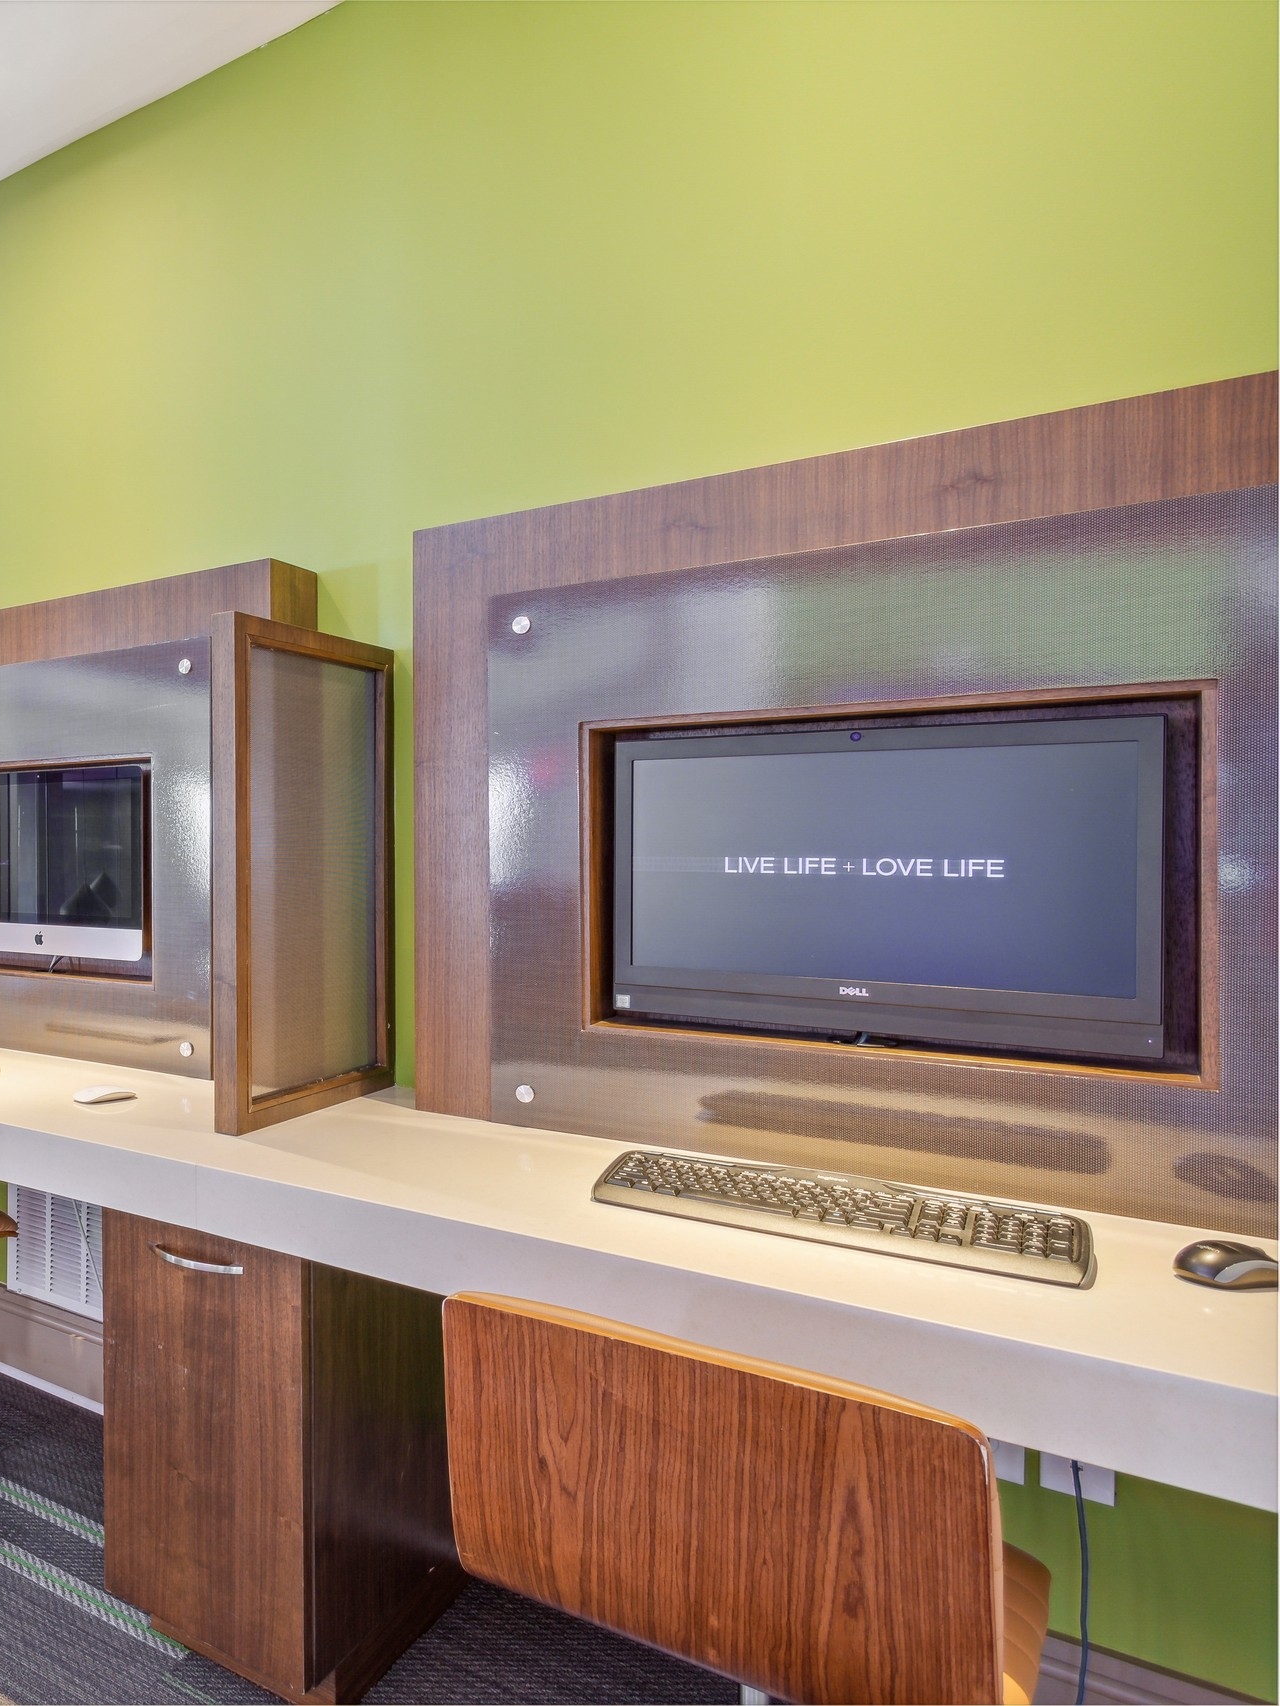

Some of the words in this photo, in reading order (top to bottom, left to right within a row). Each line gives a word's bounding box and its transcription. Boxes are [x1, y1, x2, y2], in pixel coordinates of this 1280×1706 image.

[724, 856, 775, 874] LIVE
[783, 857, 837, 875] LIFE
[862, 857, 933, 877] LOVE
[943, 858, 1005, 878] LIFE
[839, 986, 869, 997] DELL
